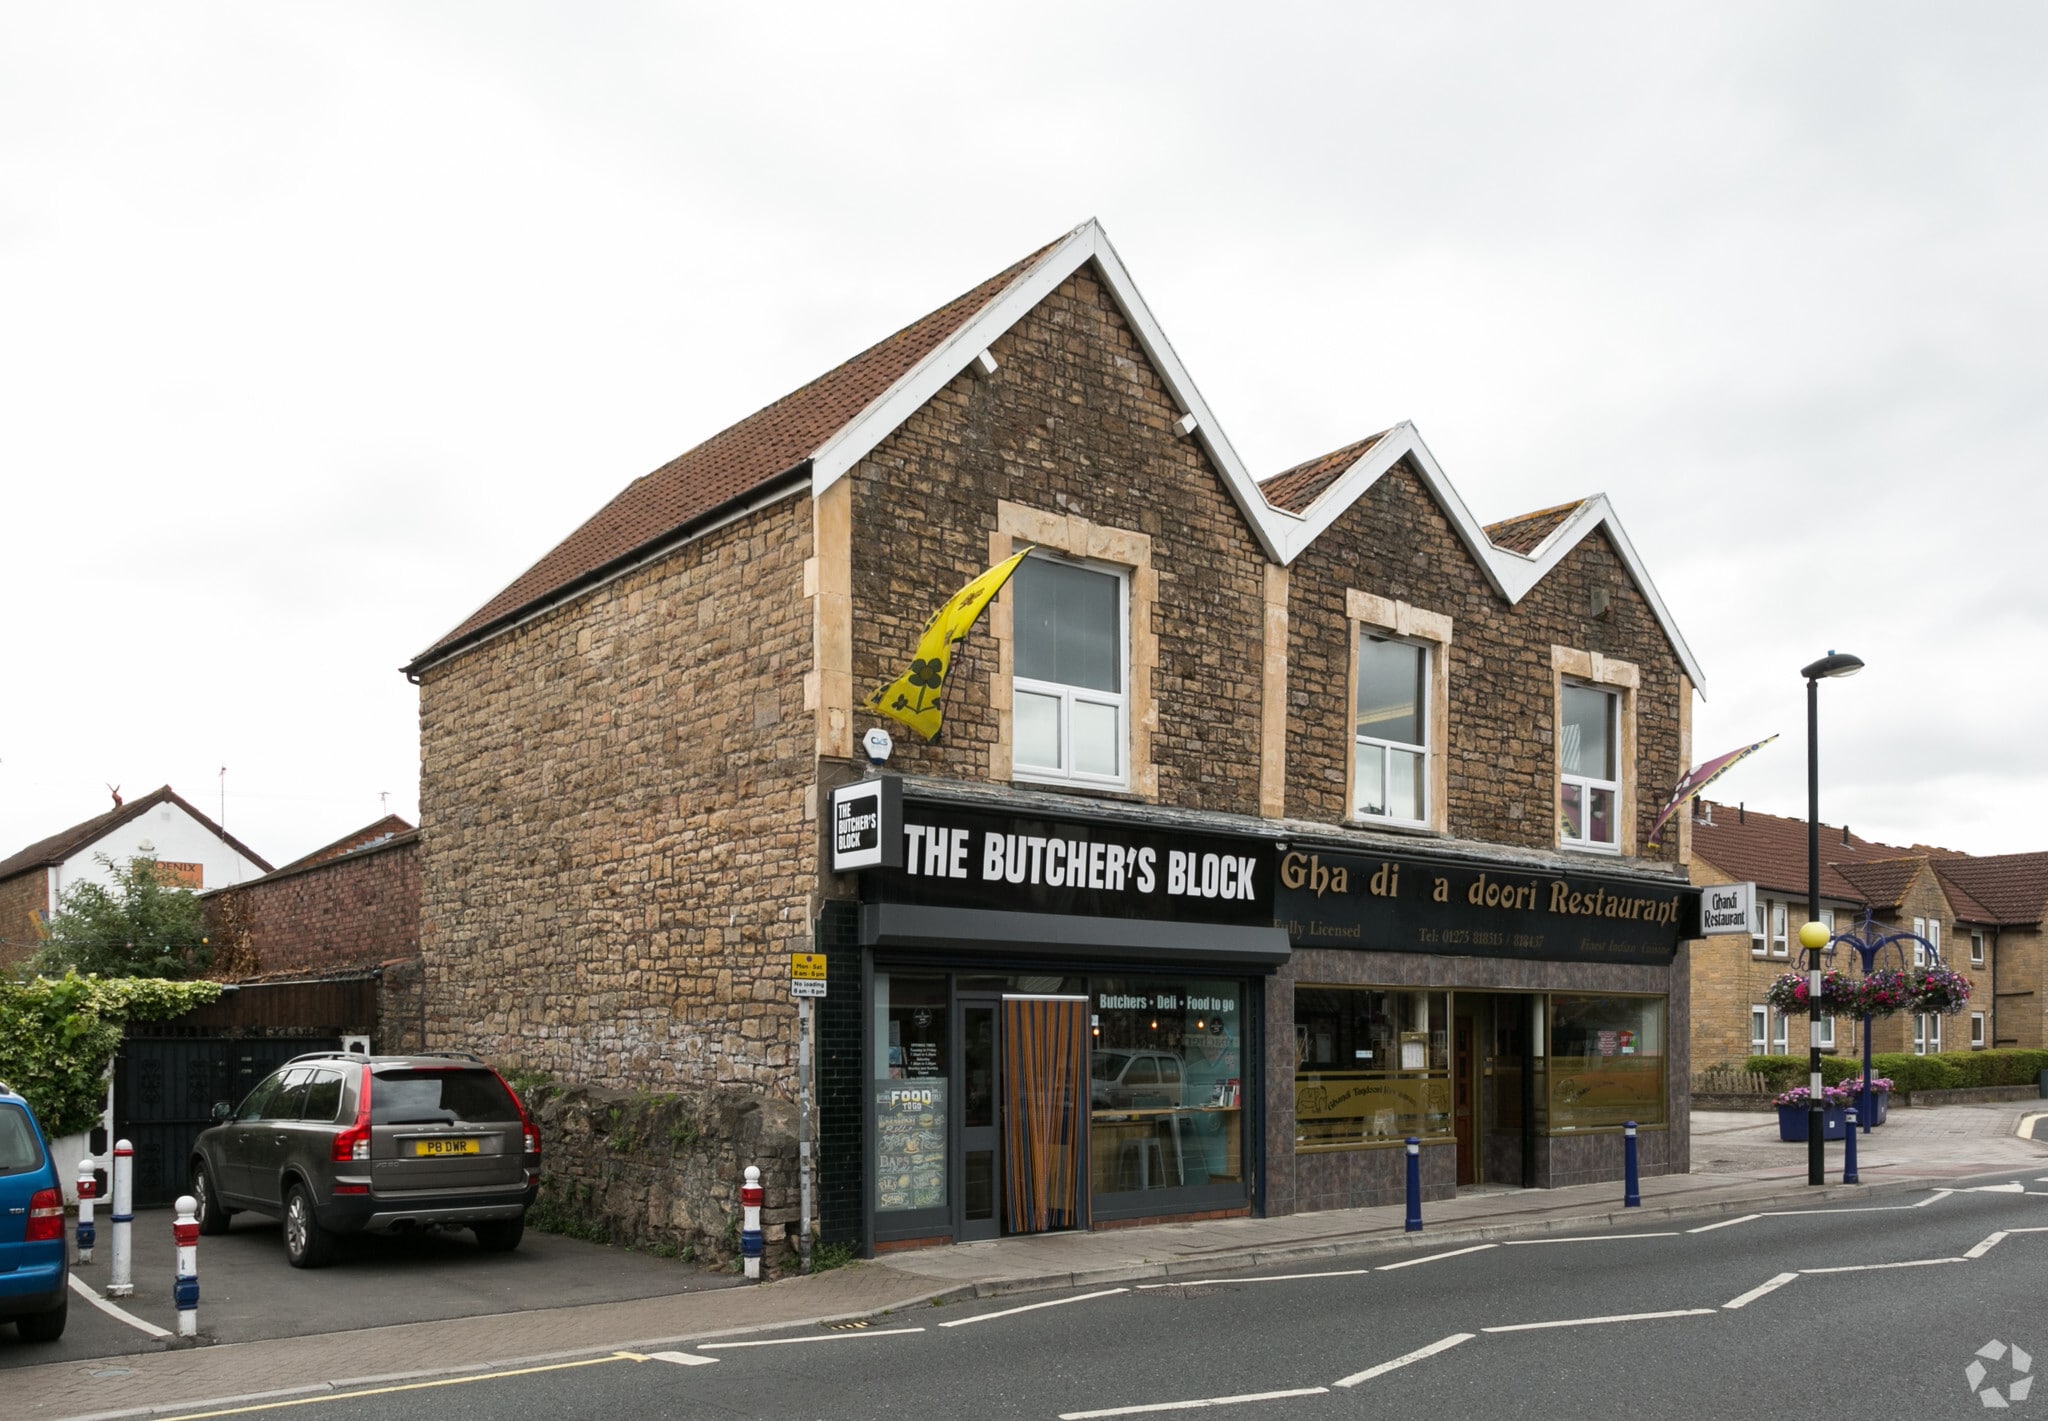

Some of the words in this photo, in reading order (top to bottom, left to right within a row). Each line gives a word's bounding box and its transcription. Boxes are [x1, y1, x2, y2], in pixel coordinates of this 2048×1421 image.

[838, 802, 852, 819] THE
[838, 812, 877, 835] BUTCHER'S
[838, 831, 861, 850] BLOCK
[904, 823, 970, 879] THE
[982, 831, 1157, 894] BUTCHER'S
[1167, 850, 1257, 900] BLOCK
[1548, 880, 1680, 928] Restaurant
[1712, 891, 1738, 911] Ghandi
[1704, 909, 1745, 928] Restaurant
[1310, 921, 1361, 938] Licensed
[1442, 929, 1470, 944] 01275
[803, 981, 825, 989] loading
[1099, 993, 1147, 1009] Butchers
[1157, 995, 1177, 1010] Deli
[1186, 996, 1210, 1011] Food
[1211, 997, 1220, 1011] to
[1222, 999, 1235, 1012] go
[891, 1090, 932, 1107] FOOD
[427, 1142, 443, 1153] P8
[445, 1141, 468, 1152] DWR
